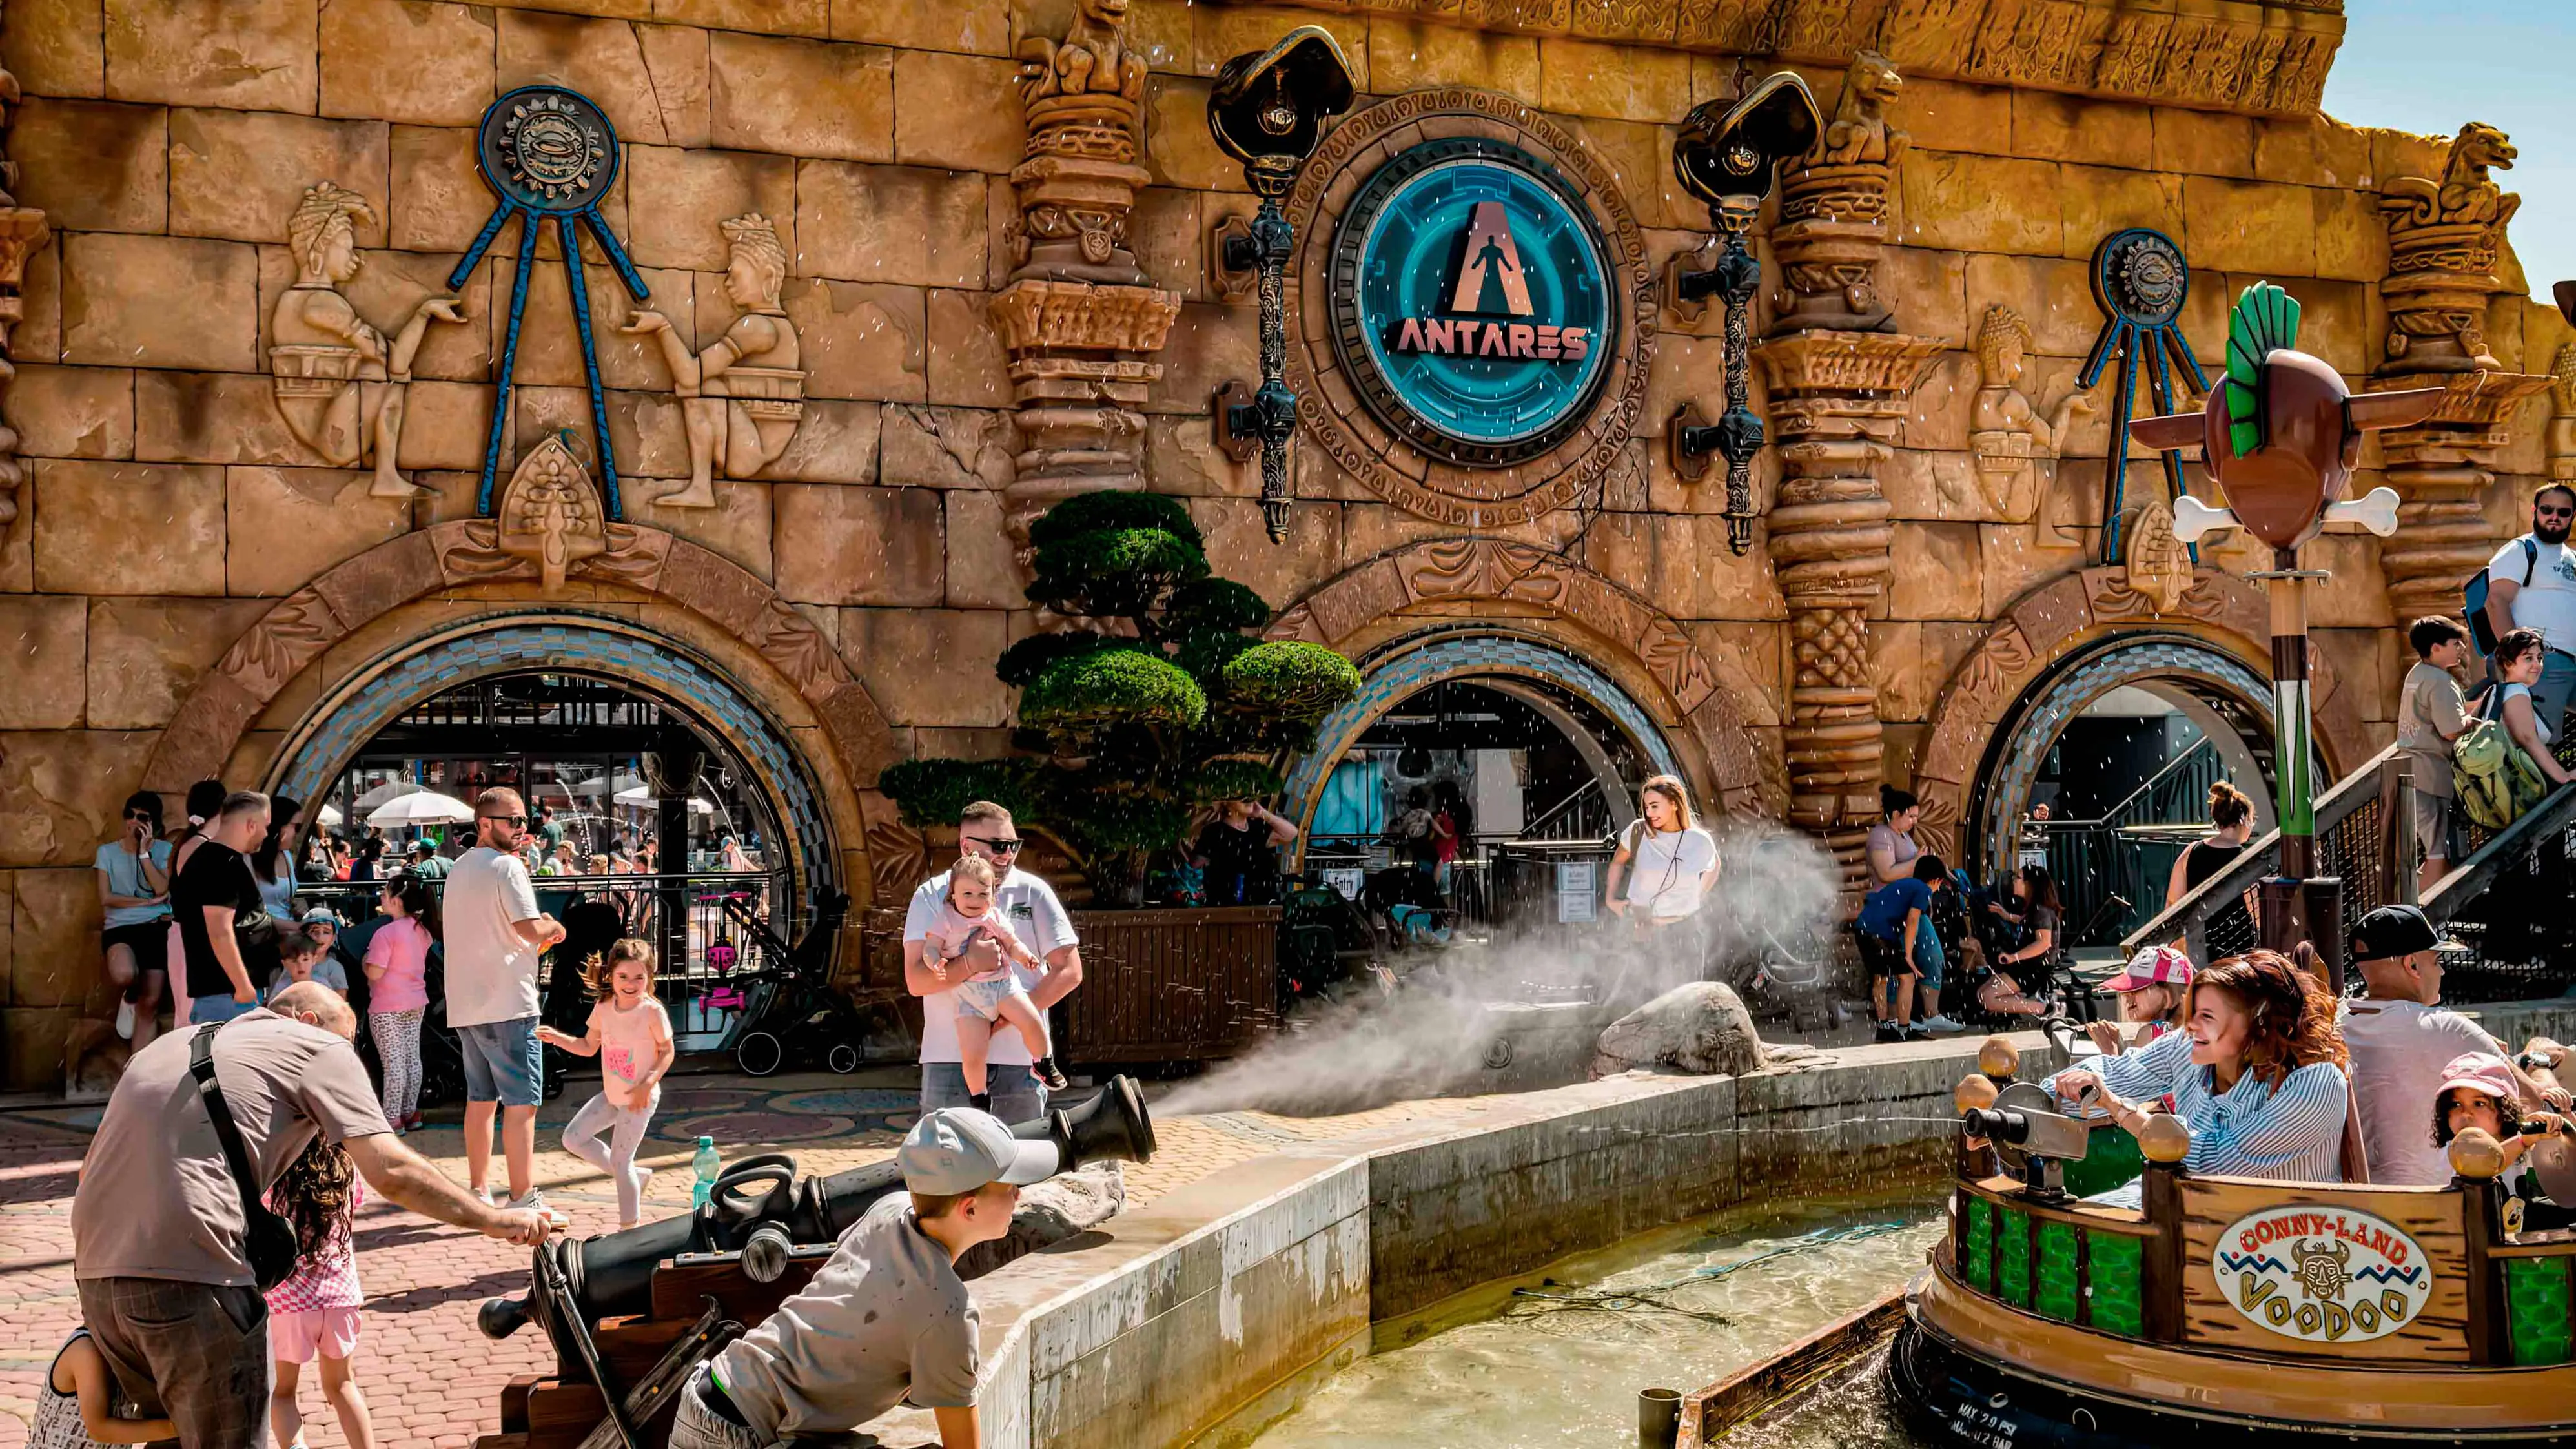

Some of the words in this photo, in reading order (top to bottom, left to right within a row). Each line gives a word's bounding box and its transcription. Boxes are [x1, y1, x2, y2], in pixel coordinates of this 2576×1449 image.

[1397, 318, 1589, 360] ANTARES
[1334, 876, 1354, 894] Entry
[2240, 1214, 2408, 1266] CONNY-LAND
[2240, 1271, 2408, 1341] VOODOO
[1958, 1403, 1978, 1419] MAX
[1998, 1420, 2018, 1437] PSI
